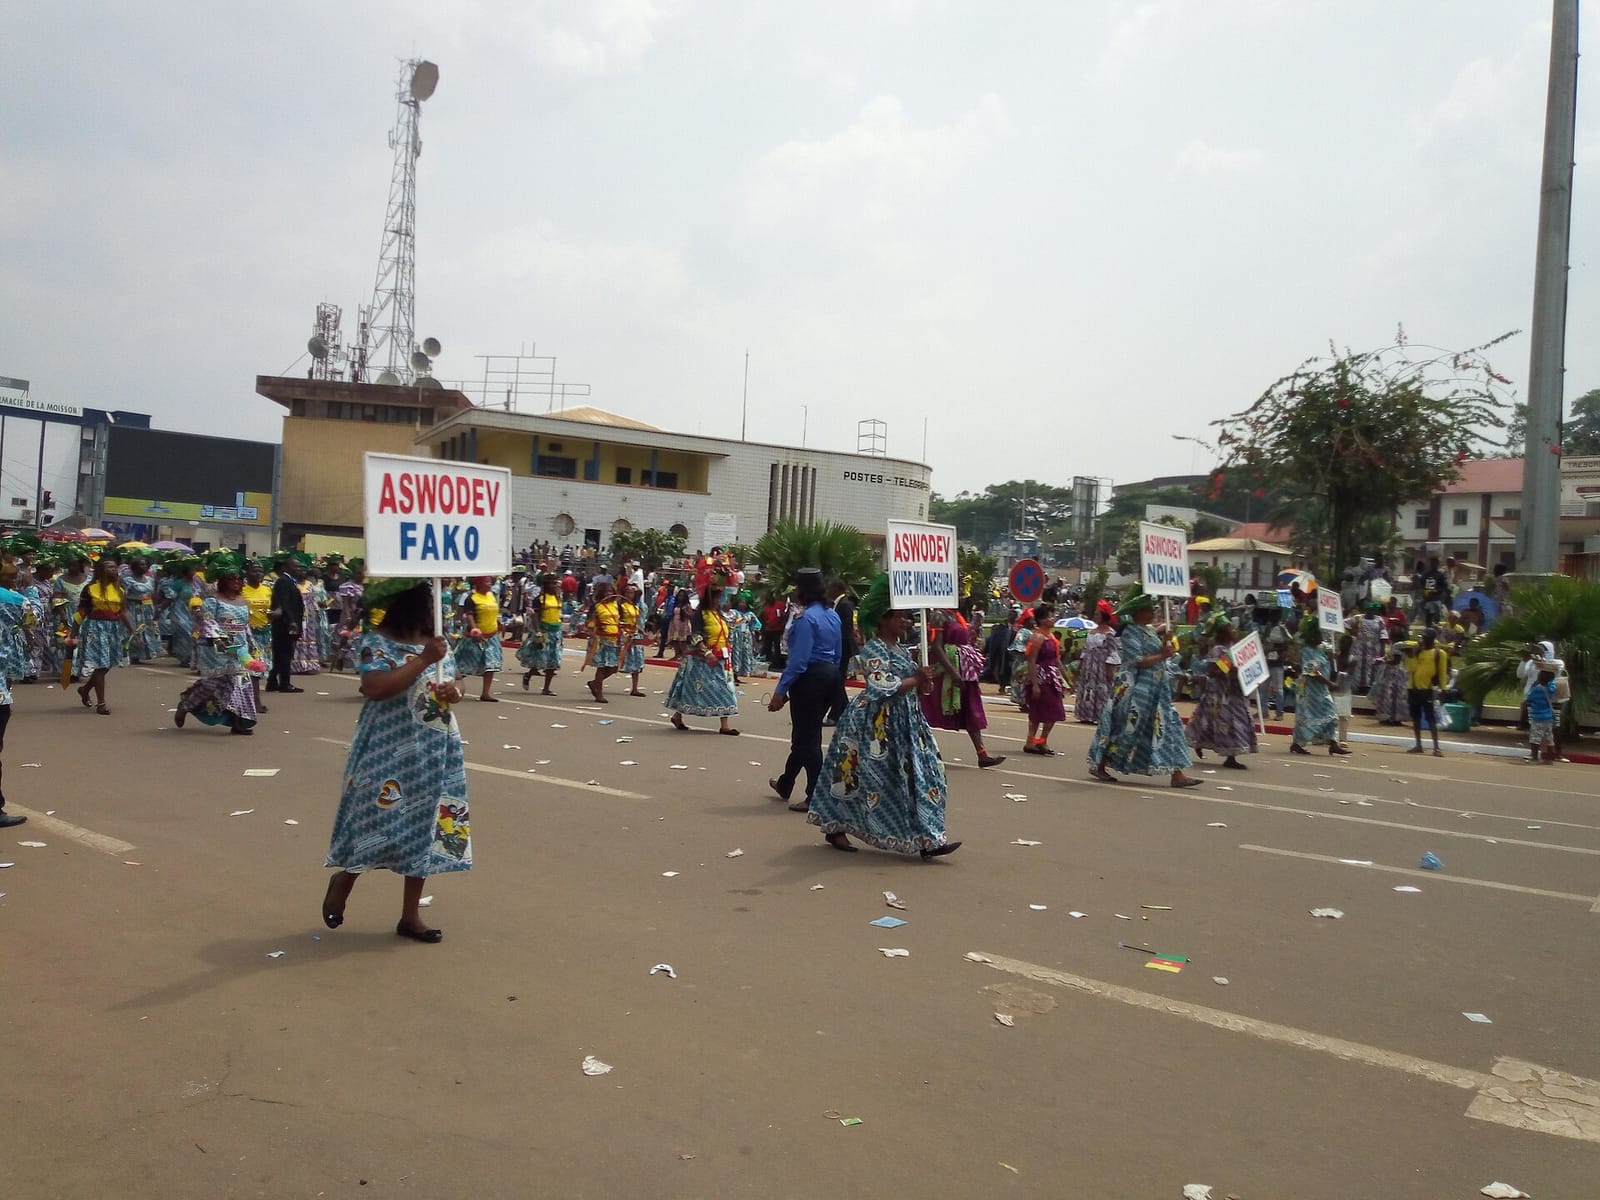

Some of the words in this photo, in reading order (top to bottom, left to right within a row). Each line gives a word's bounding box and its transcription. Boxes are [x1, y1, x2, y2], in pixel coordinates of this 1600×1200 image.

[26, 400, 35, 408] DE
[37, 401, 45, 410] LA
[46, 403, 77, 414] MOISSON
[843, 471, 883, 484] POSTES
[378, 472, 500, 517] ASWODEV
[400, 521, 479, 561] FAKO
[894, 532, 950, 563] ASWODEV
[1144, 534, 1182, 560] ASWODEV
[893, 570, 912, 596] KUPE
[1147, 562, 1184, 586] NDIAN
